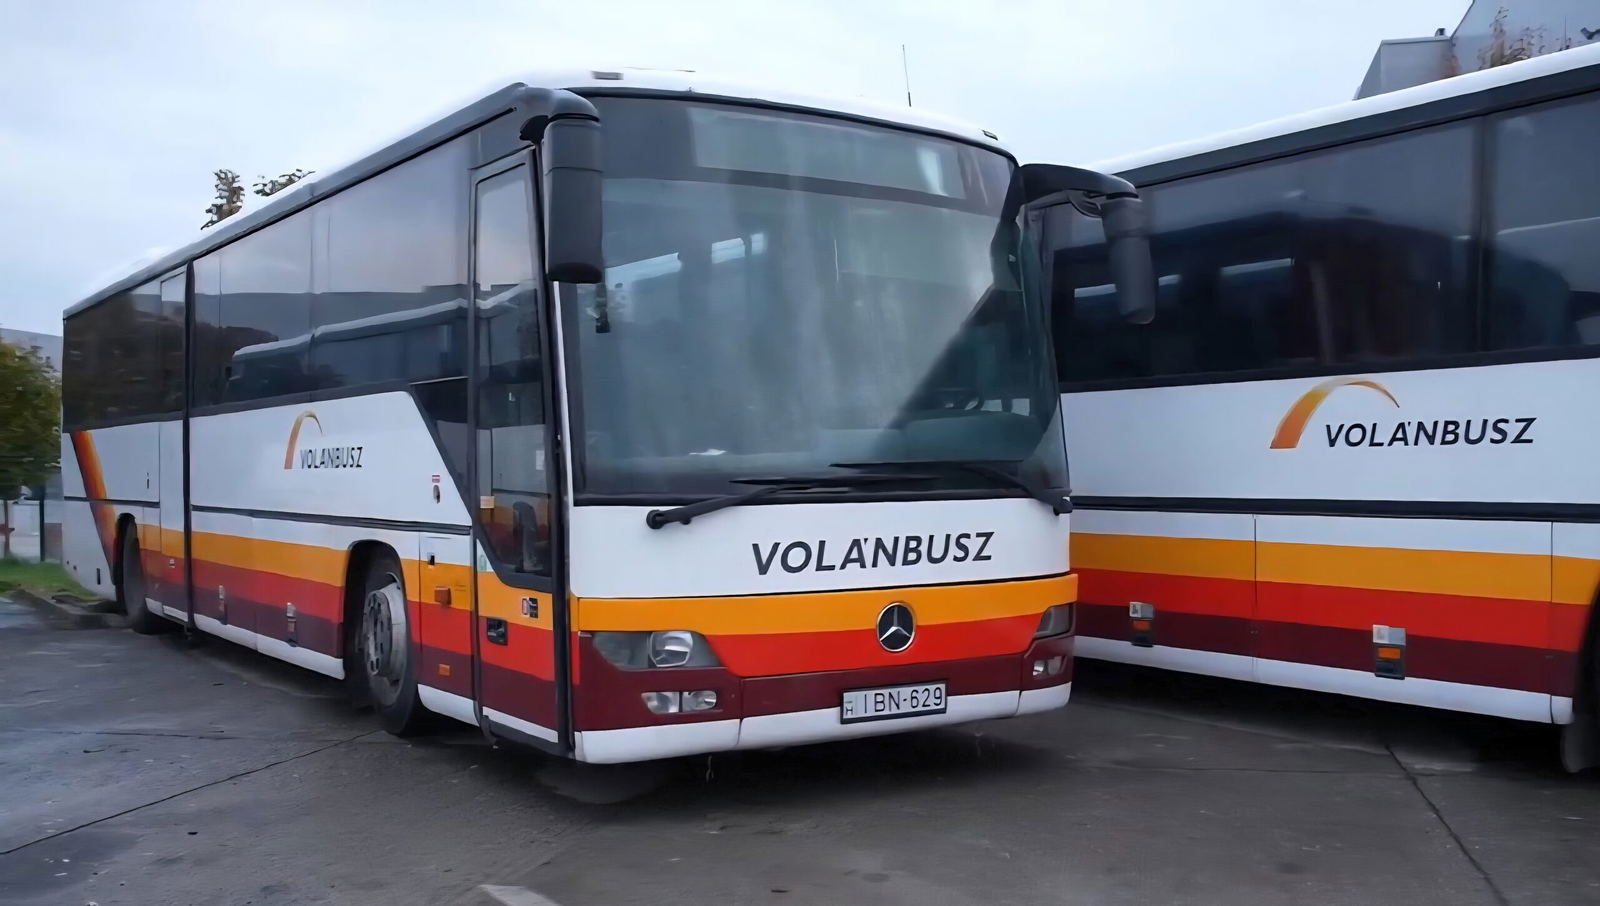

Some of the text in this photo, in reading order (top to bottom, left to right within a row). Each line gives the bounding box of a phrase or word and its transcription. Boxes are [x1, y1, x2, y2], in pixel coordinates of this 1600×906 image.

[1325, 417, 1537, 448] VOLÁNBUSZ
[752, 531, 995, 576] VOLÁNBUSZ
[864, 686, 943, 714] IBN-629
